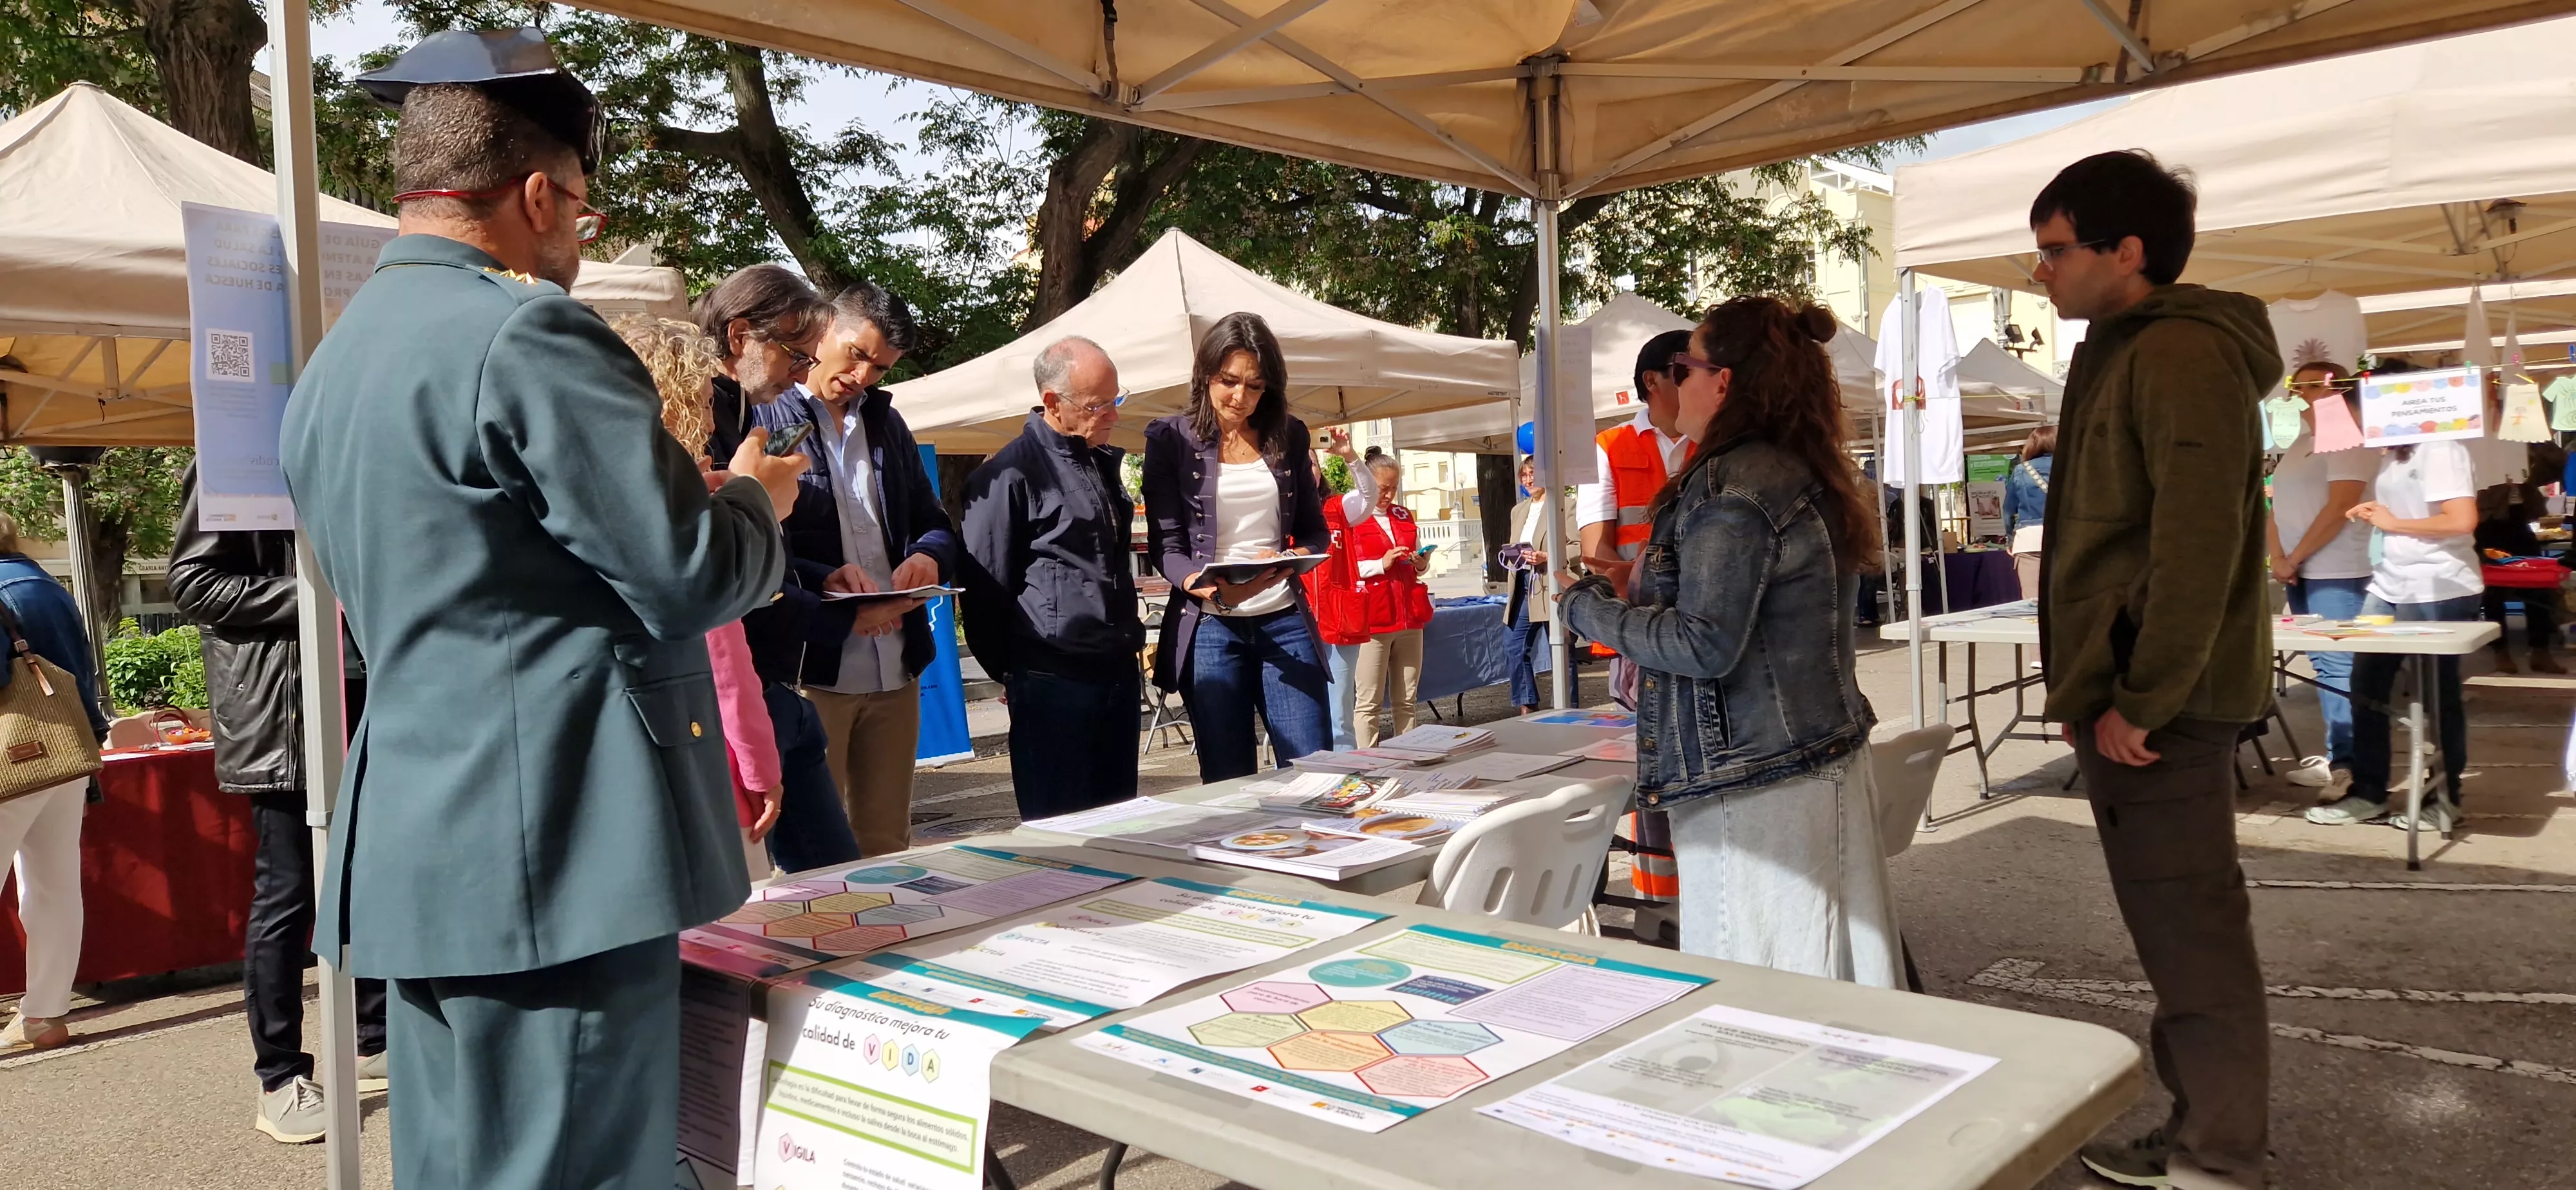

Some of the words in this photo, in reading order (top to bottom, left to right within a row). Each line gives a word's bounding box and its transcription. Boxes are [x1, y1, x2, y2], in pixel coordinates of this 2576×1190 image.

[2401, 398, 2427, 406] AIREA
[2391, 406, 2458, 417] PENSAMIENTOS
[808, 996, 822, 1010] Su
[824, 1001, 889, 1025] diagnóstico
[889, 1018, 934, 1036] mejora
[934, 1031, 951, 1041] tu
[802, 1025, 840, 1046] calidad
[842, 1033, 855, 1051] de
